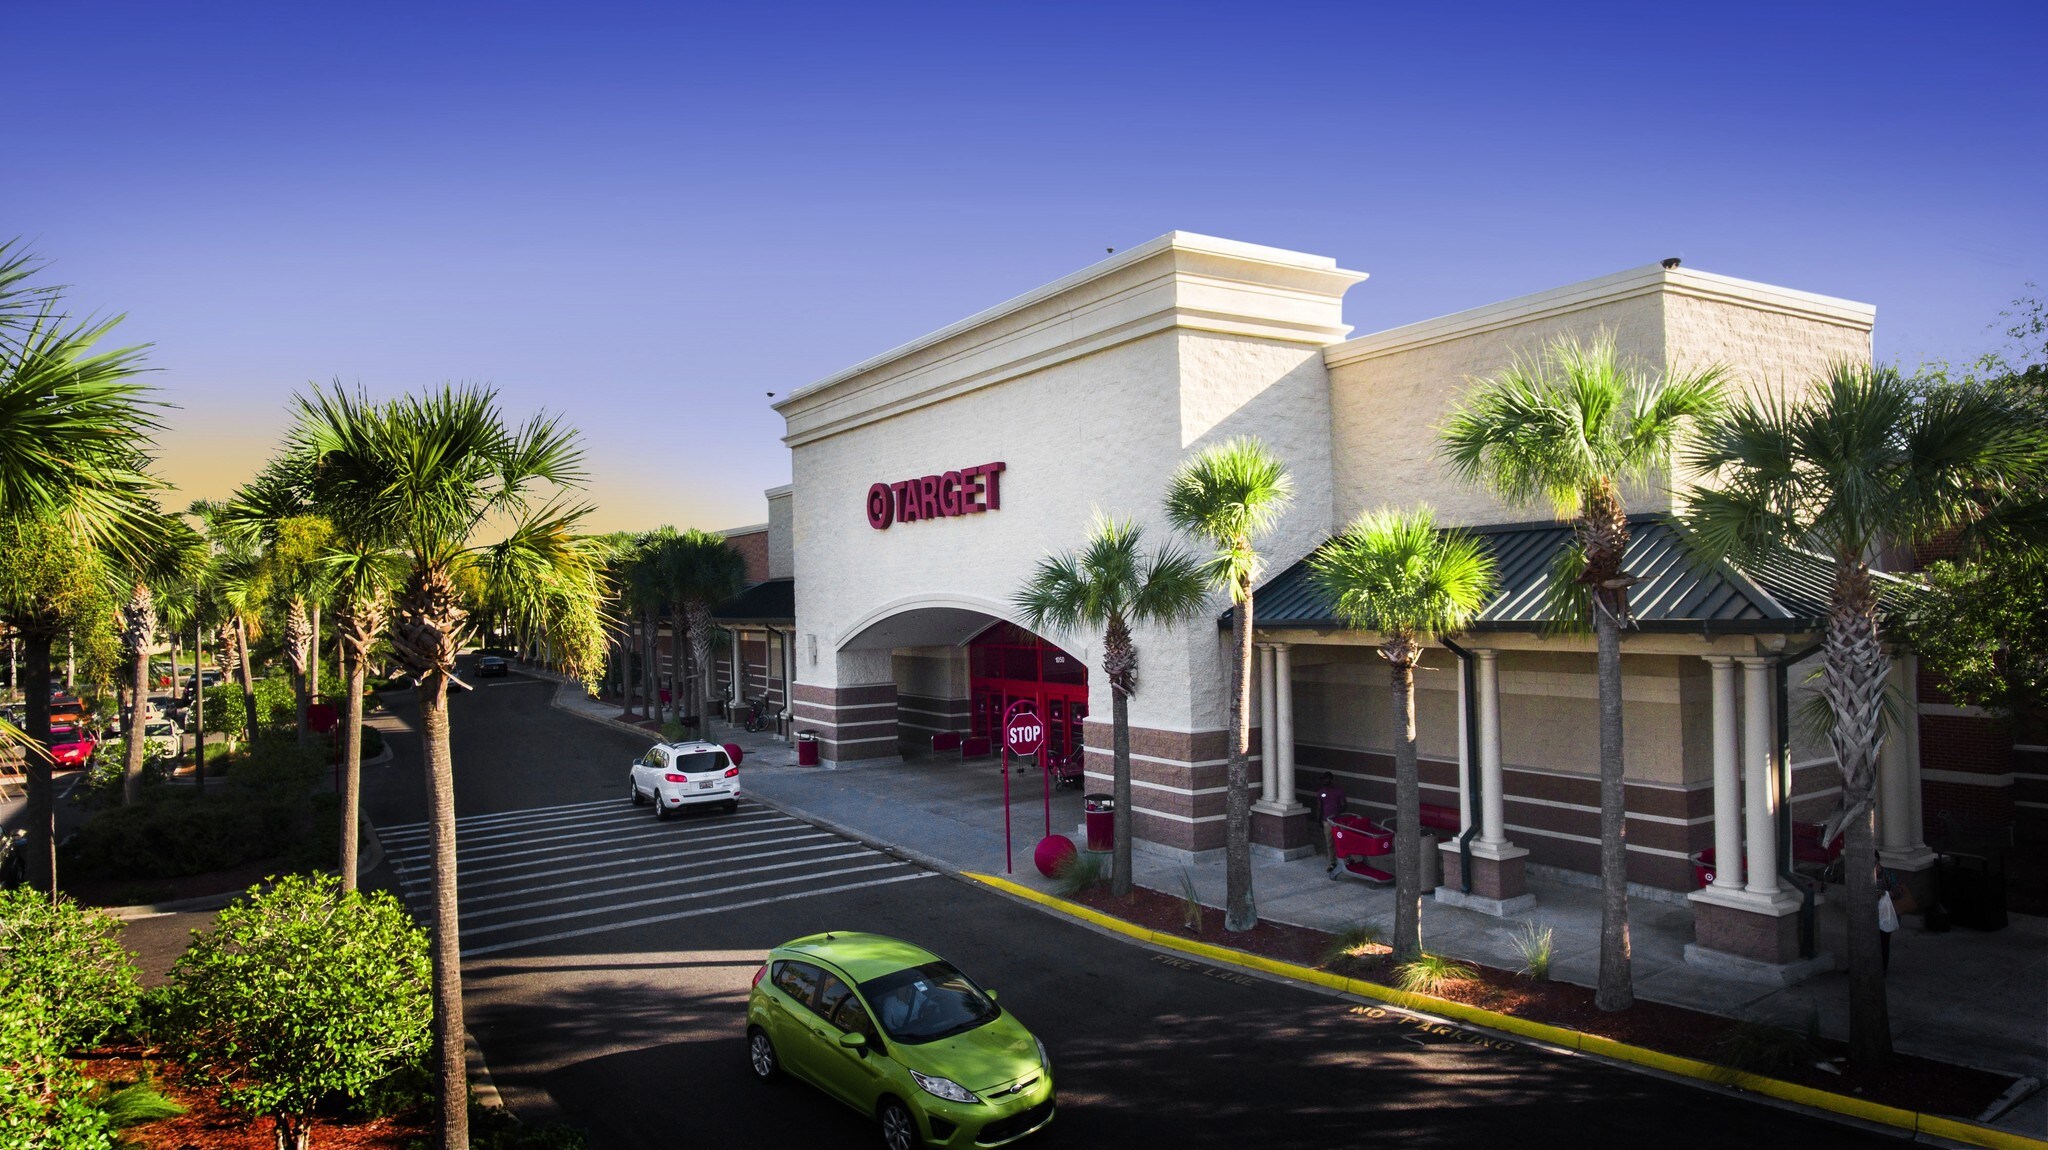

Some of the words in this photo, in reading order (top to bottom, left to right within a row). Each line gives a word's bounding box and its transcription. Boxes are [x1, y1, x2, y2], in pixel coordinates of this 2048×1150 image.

[891, 462, 1006, 522] TARGET
[1010, 725, 1040, 744] STOP
[1151, 954, 1199, 970] FIRE
[1202, 968, 1262, 987] LANE
[1350, 1006, 1387, 1019] NO
[1398, 1015, 1515, 1051] PARKING
